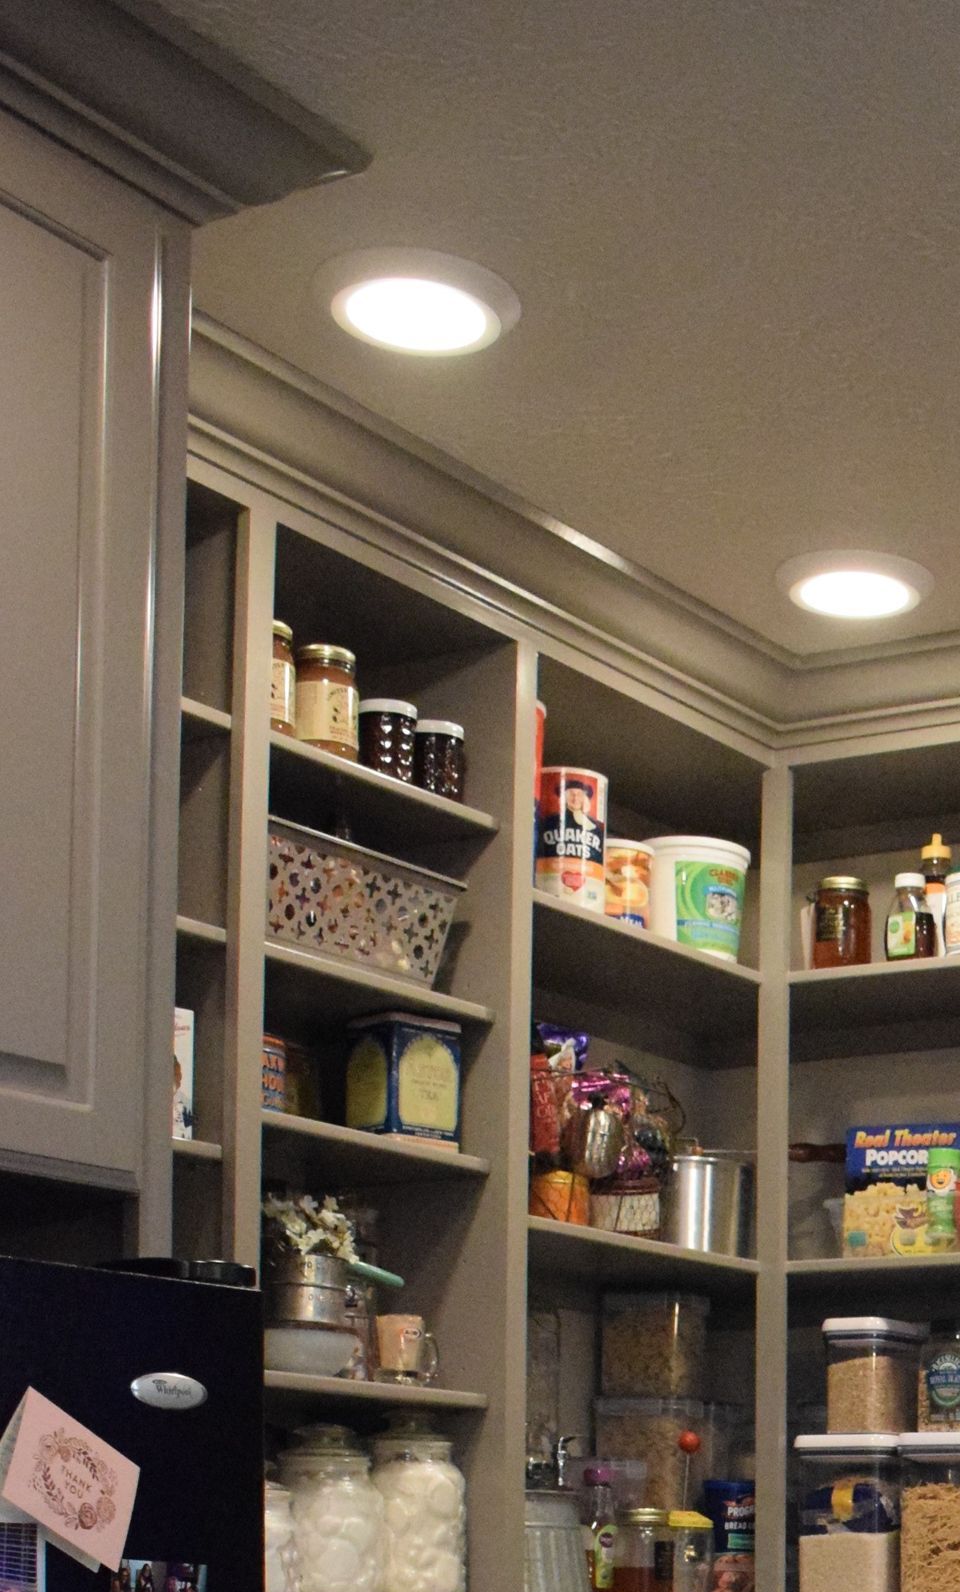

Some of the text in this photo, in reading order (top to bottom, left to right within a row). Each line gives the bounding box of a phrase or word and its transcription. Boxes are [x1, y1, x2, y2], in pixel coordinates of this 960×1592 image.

[544, 828, 602, 853] QUAKER
[556, 842, 592, 859] OATS
[855, 1128, 958, 1149] Real Theater
[865, 1148, 929, 1167] POPCOR
[156, 1384, 194, 1399] Whirlpool
[61, 1464, 93, 1492] THANK
[65, 1481, 84, 1499] YOU
